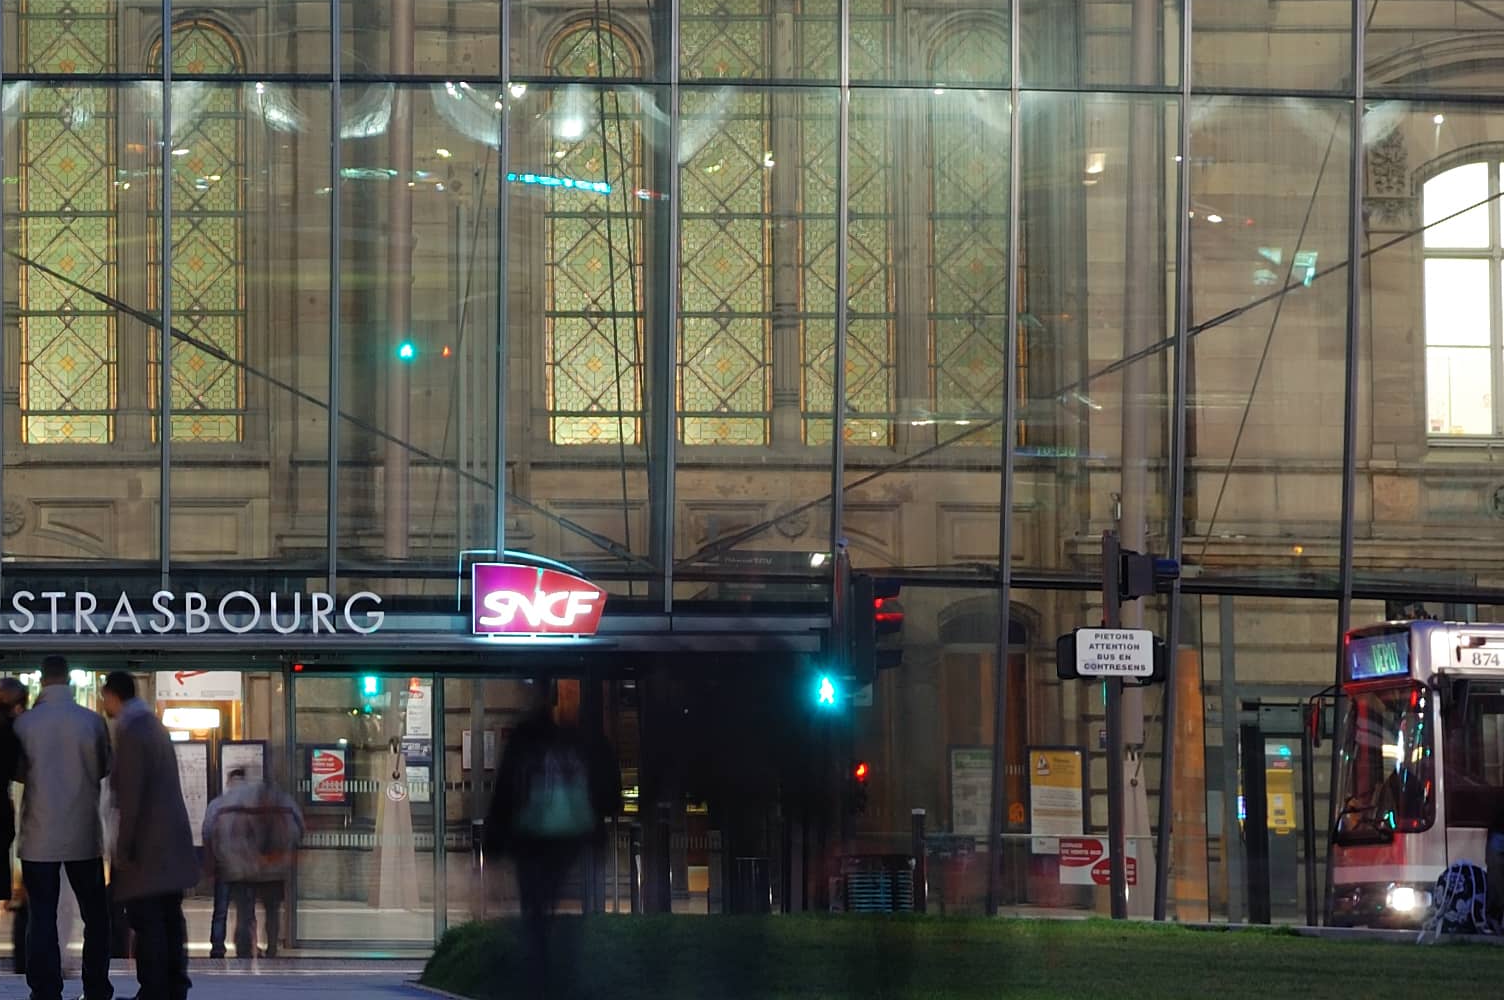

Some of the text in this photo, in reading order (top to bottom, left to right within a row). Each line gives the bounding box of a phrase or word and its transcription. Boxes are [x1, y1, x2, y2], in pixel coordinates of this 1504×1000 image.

[8, 590, 385, 634] STRASBOURG
[479, 590, 600, 627] SNCF
[1084, 663, 1146, 671] CONTRESENS
[1472, 652, 1500, 666] 874
